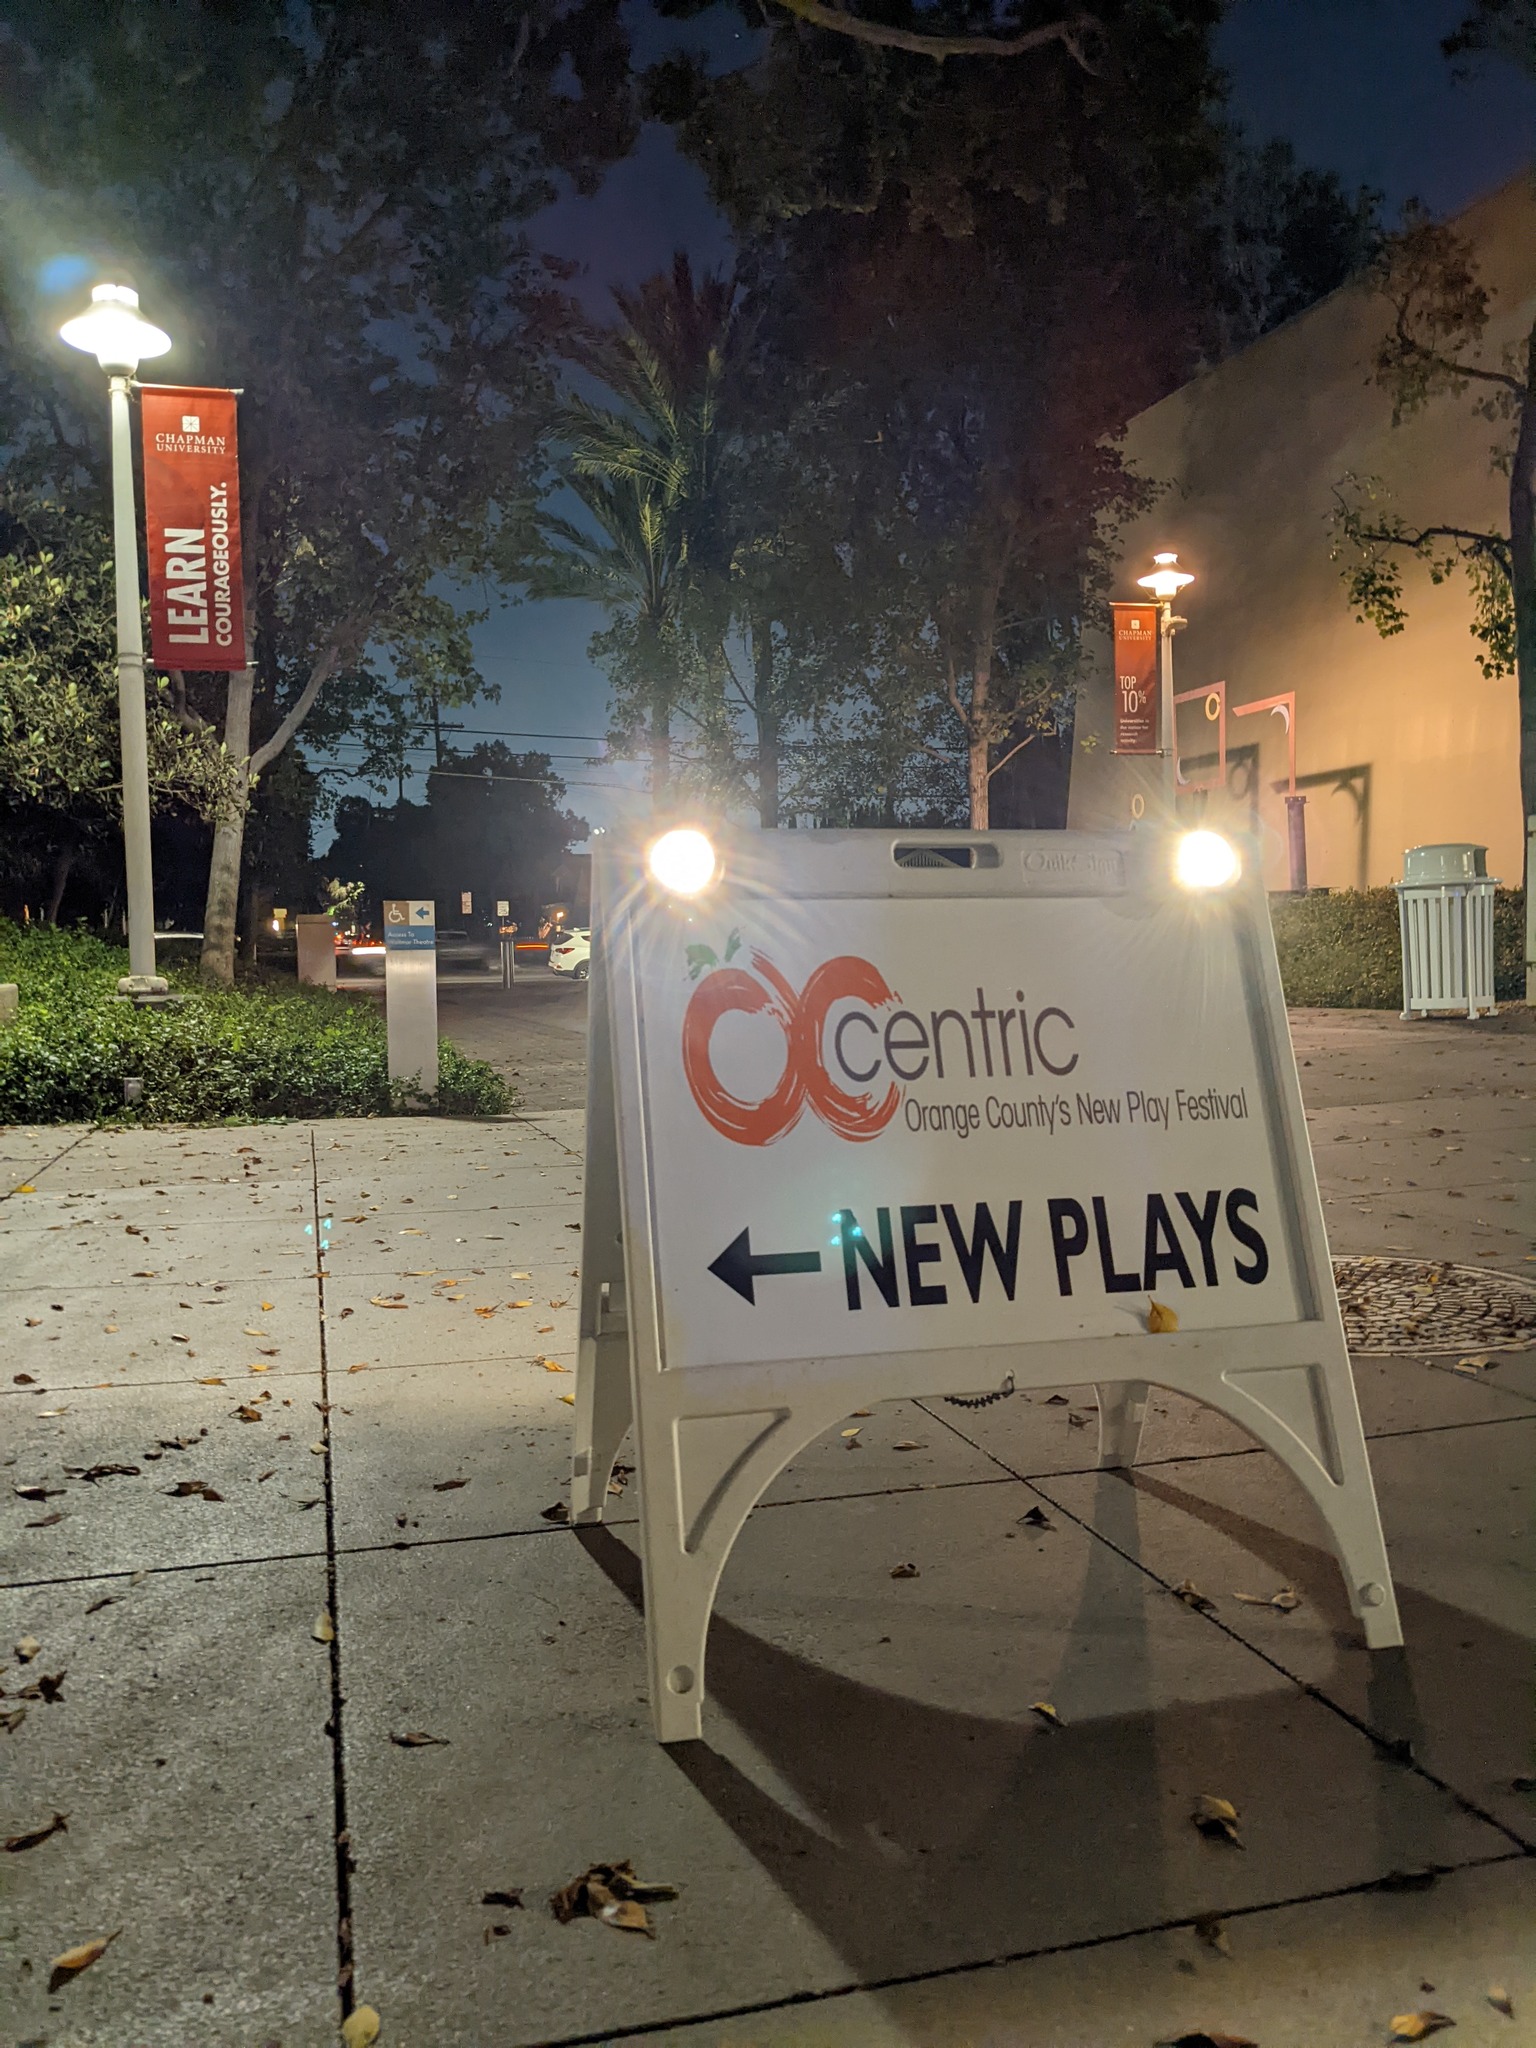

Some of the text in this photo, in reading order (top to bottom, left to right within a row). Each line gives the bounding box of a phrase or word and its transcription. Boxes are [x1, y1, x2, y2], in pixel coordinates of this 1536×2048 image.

[155, 432, 226, 446] CHAPMAN
[156, 443, 226, 455] UNIVERSITY
[210, 482, 232, 647] COURAGEOUSLY.
[164, 528, 209, 644] LEARN
[1120, 675, 1137, 690] TOP
[1122, 690, 1147, 713] 10%
[905, 1087, 1249, 1139] Orange County's New Play Festival
[838, 1187, 1270, 1311] NEW PLAYS
